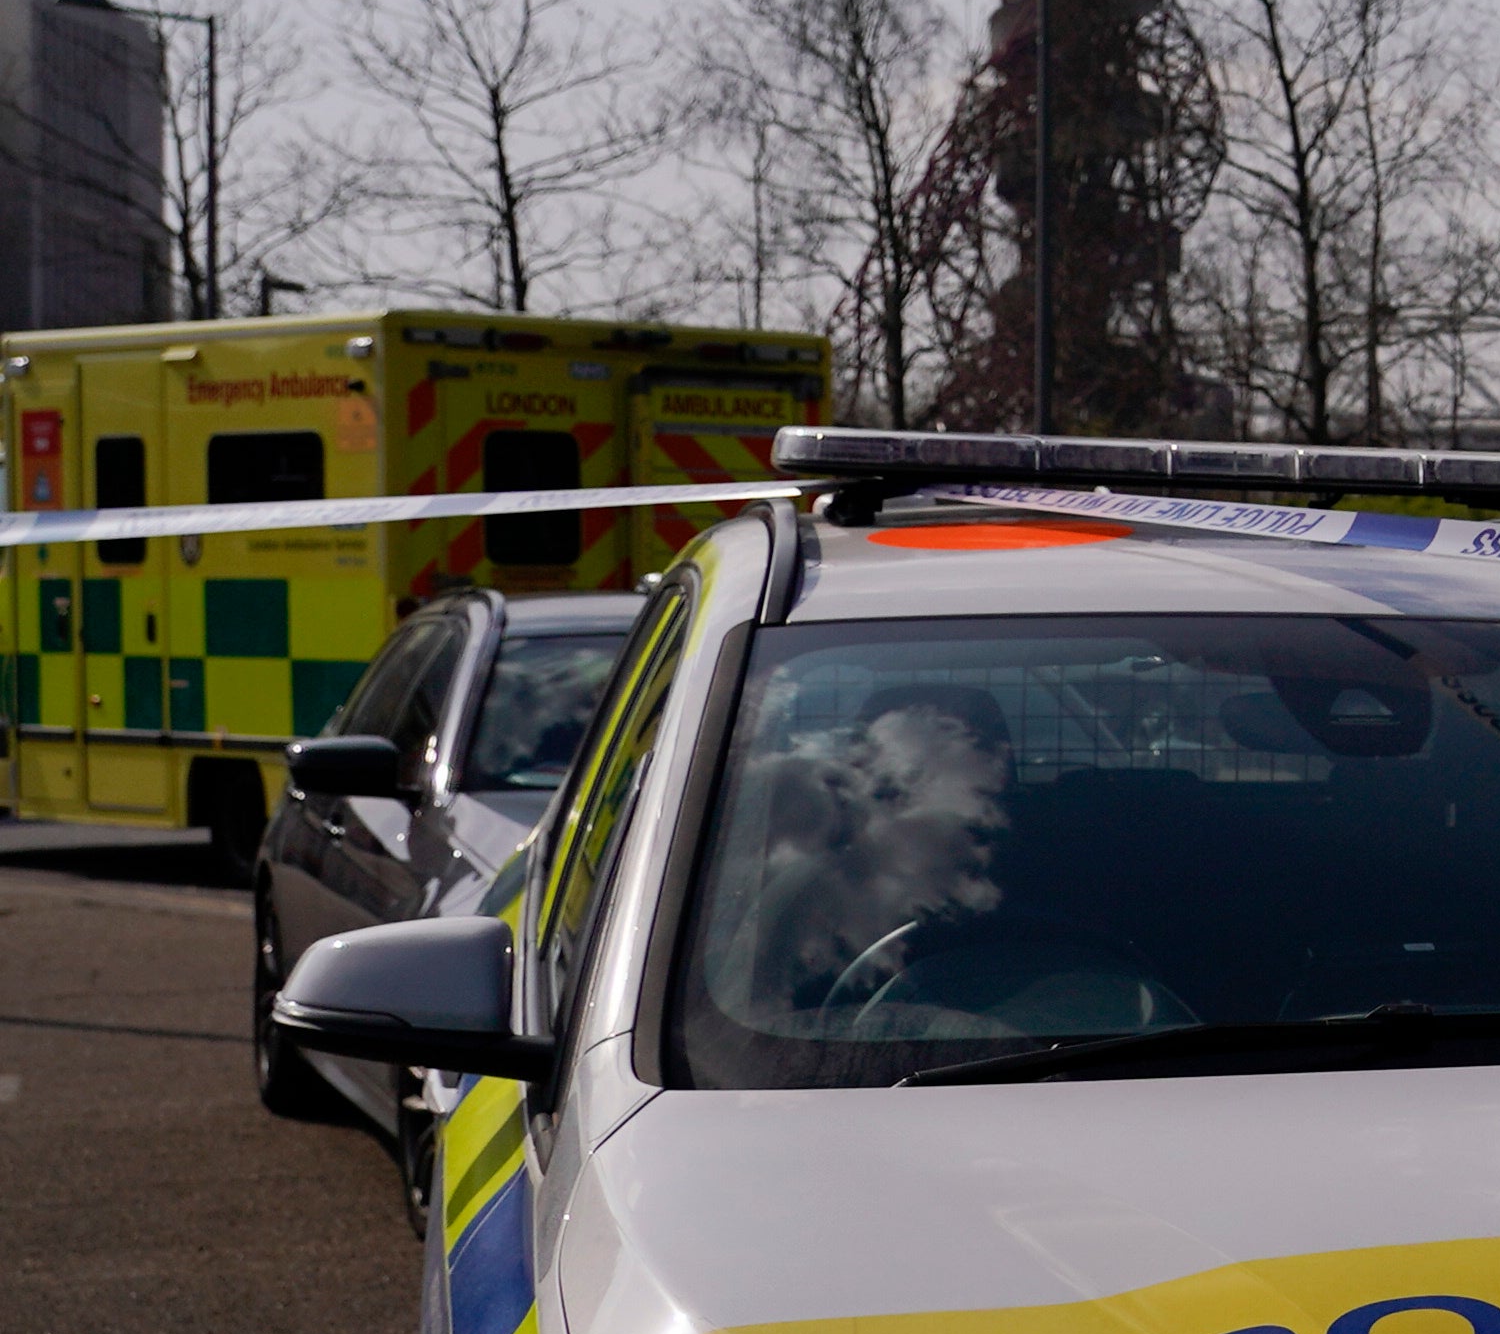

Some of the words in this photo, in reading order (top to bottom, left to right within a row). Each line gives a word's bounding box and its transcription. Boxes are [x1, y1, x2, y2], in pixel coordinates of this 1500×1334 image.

[187, 374, 264, 407] Emergency
[486, 392, 576, 416] LONDON
[661, 394, 787, 420] AMBULANCE
[1157, 502, 1220, 525] LINE
[1220, 506, 1325, 536] POLICE
